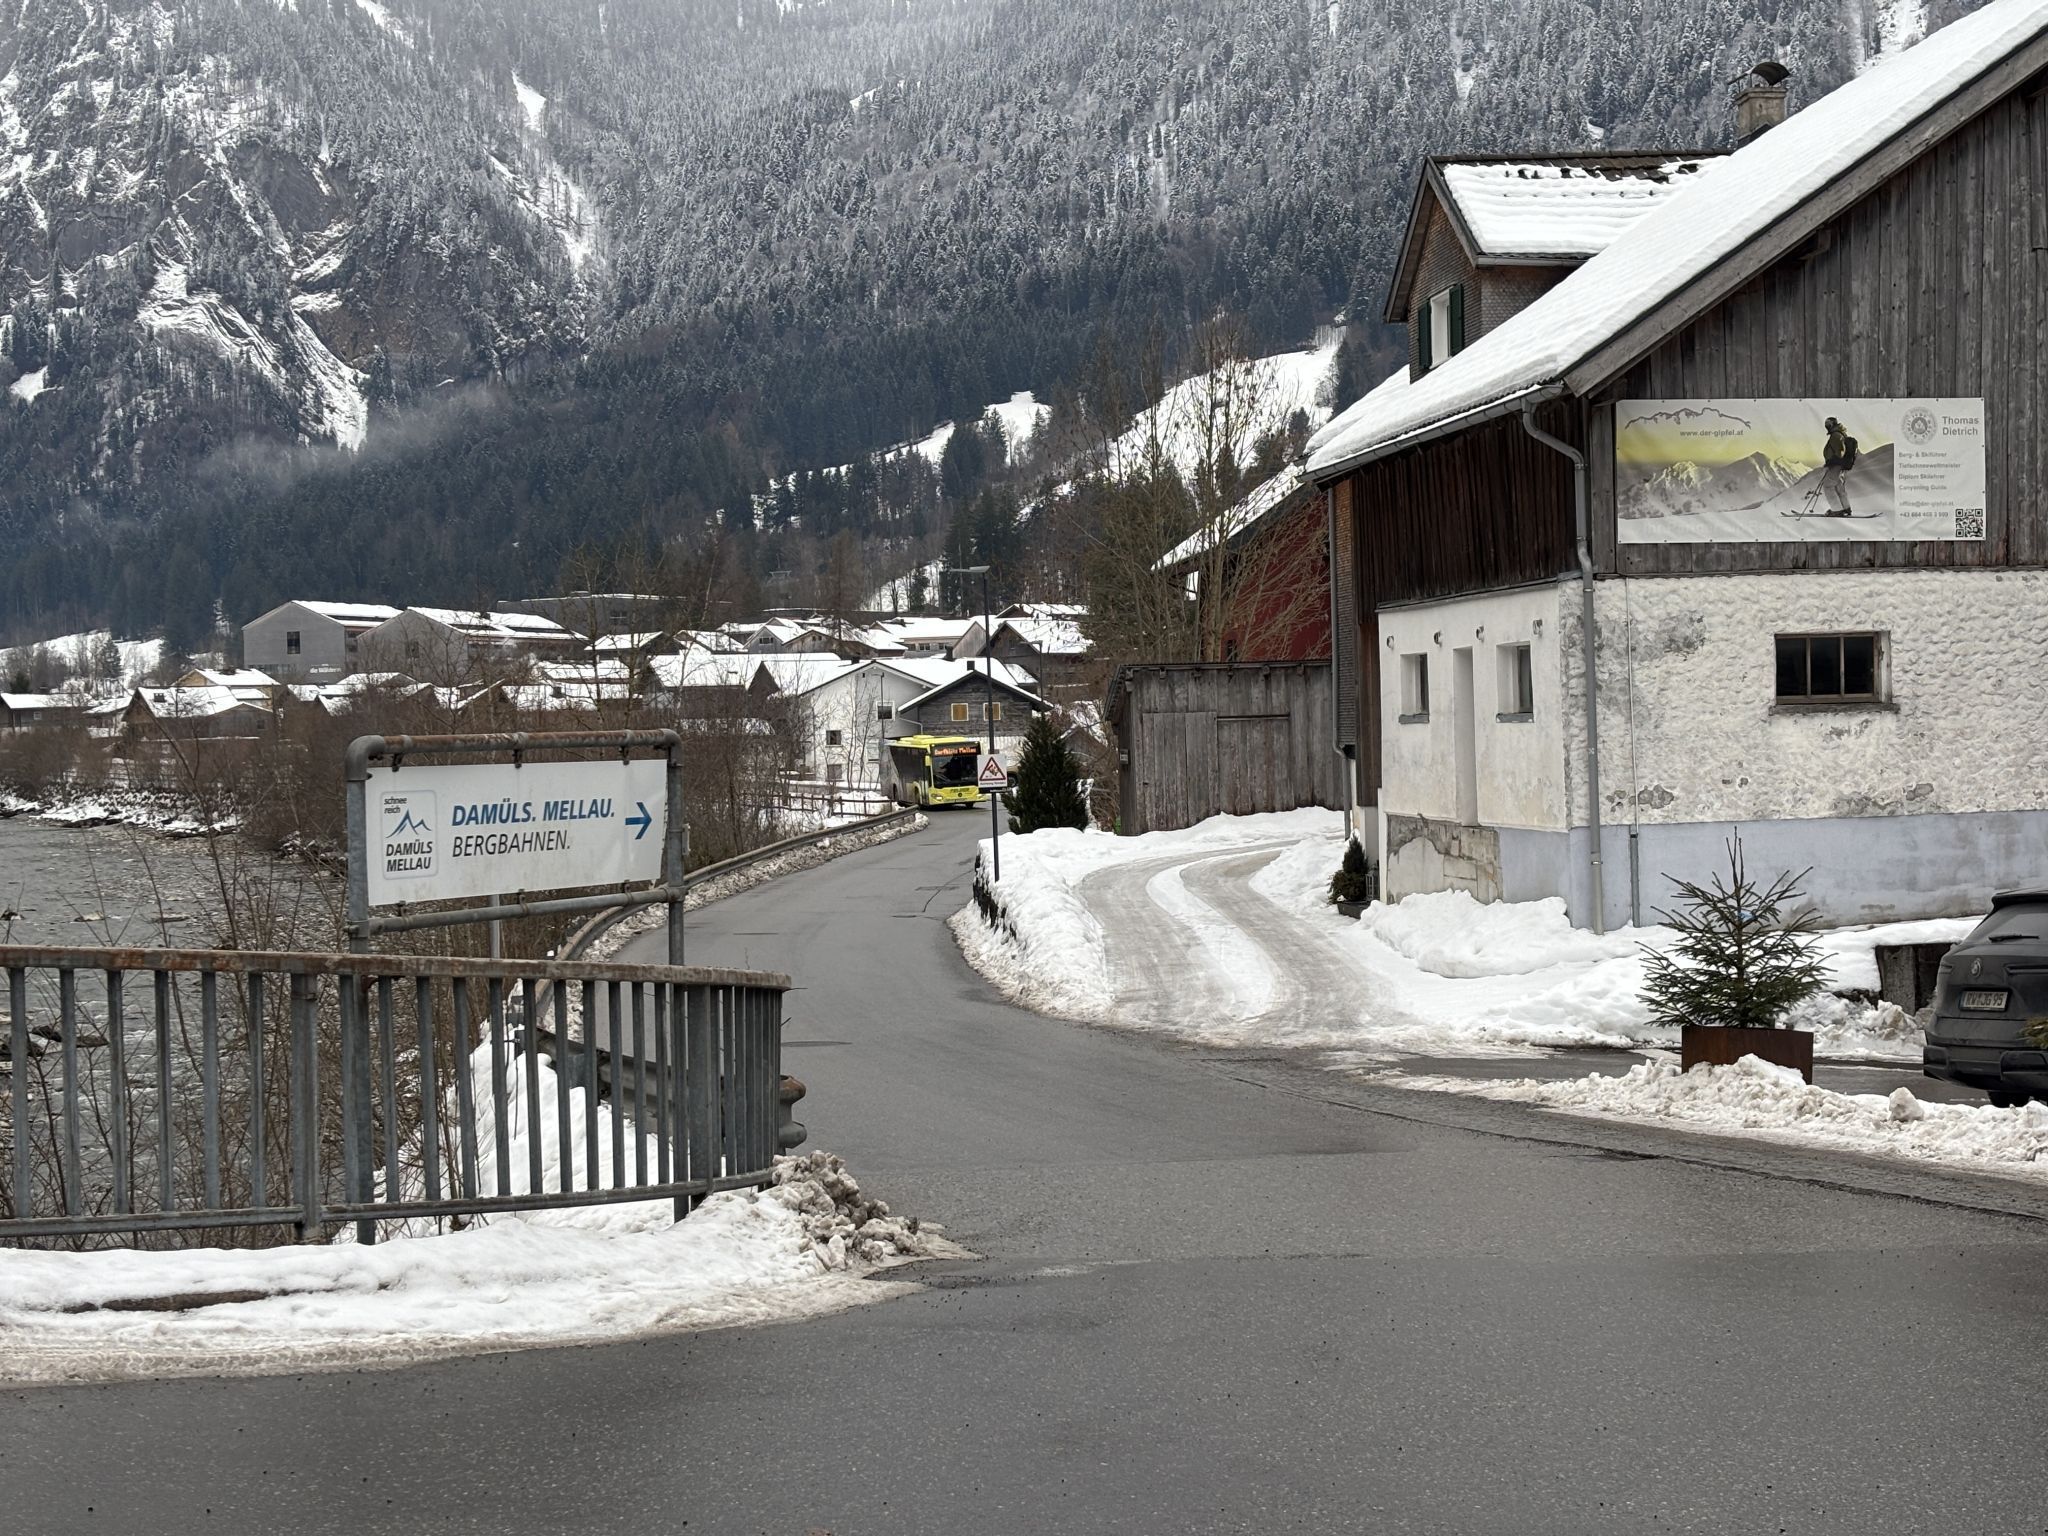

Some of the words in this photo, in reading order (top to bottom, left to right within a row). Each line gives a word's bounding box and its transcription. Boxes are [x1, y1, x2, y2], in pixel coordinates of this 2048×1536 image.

[1942, 416, 1979, 425] Thomas
[1680, 428, 1744, 438] www.der-gipfel.at
[1942, 427, 1978, 436] Dietrich
[383, 796, 407, 805] schnee
[384, 805, 400, 814] reich
[451, 798, 537, 827] DAMÜLS.
[542, 798, 615, 821] MELLAU.
[385, 839, 433, 857] DAMÜLS
[452, 830, 571, 858] BERGBAHNEN.
[386, 857, 431, 873] MELLAU
[1992, 993, 2003, 1006] 95
